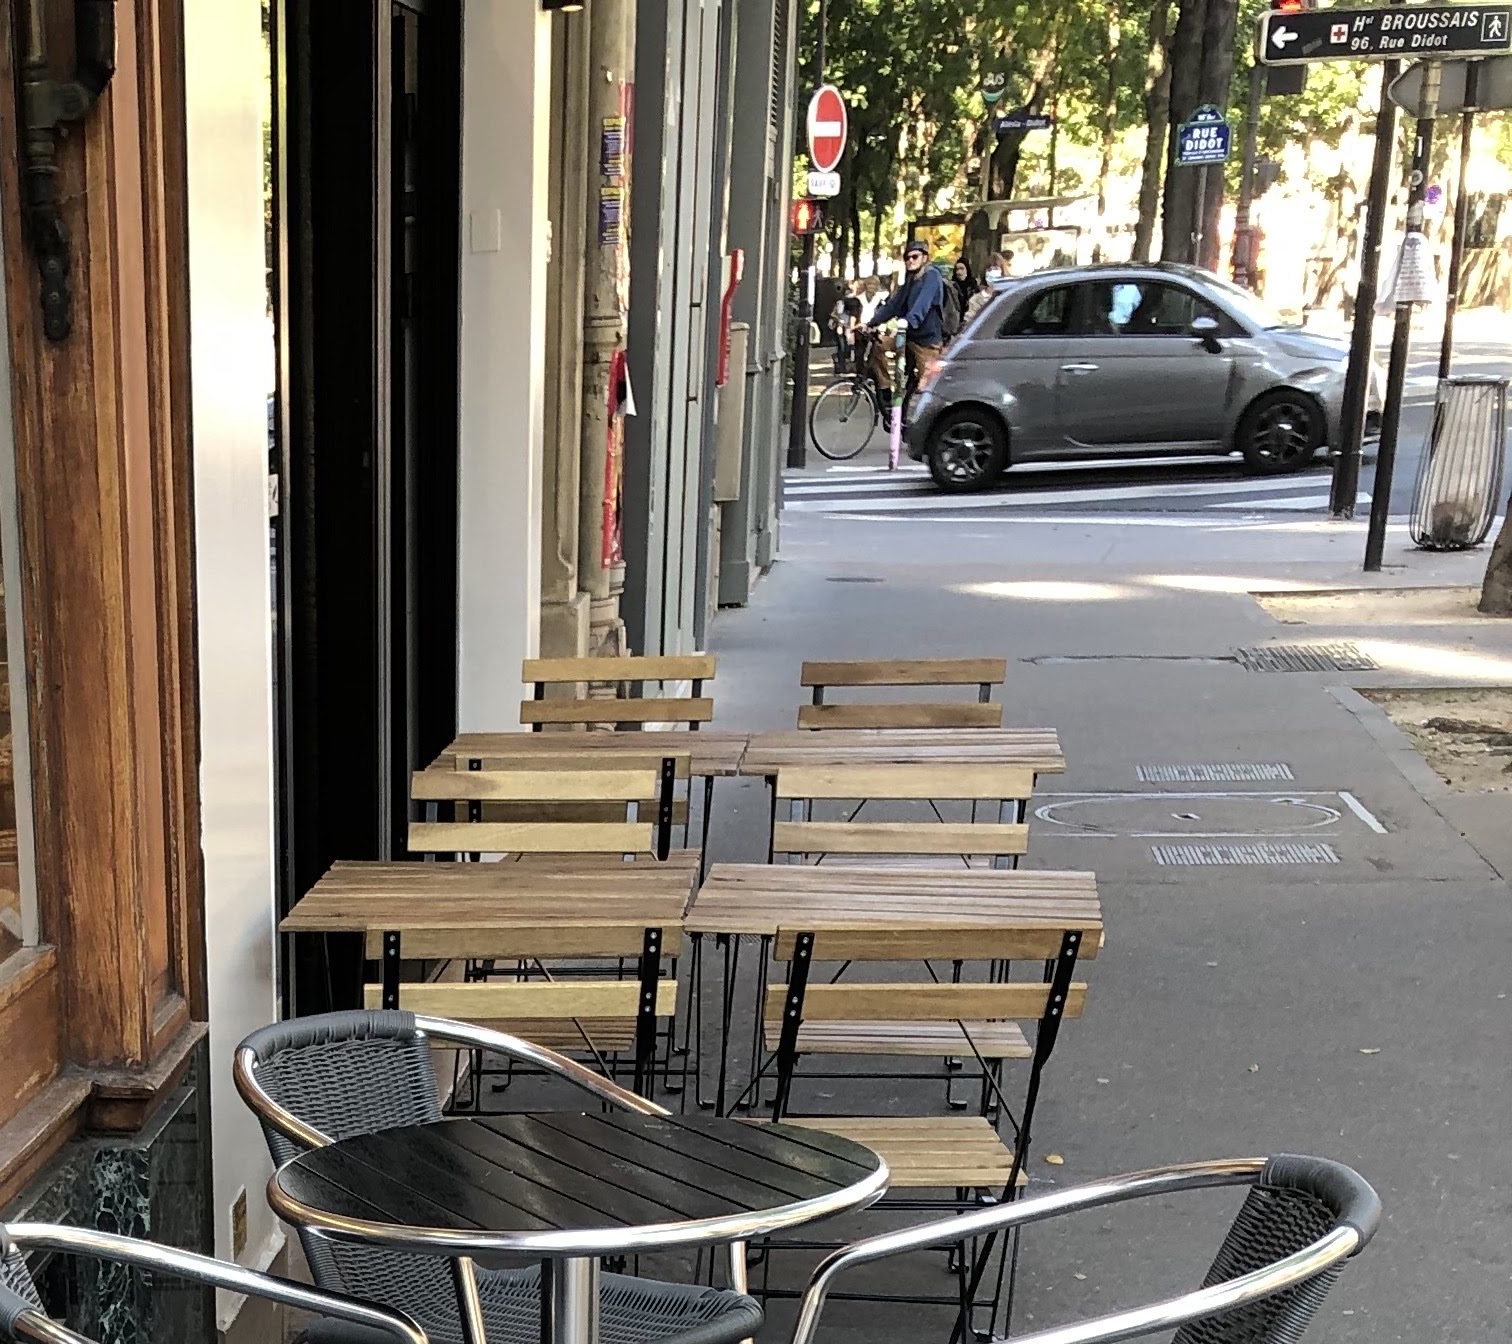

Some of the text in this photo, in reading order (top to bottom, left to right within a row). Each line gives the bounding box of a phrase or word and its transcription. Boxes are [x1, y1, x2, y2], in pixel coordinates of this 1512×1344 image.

[1381, 11, 1479, 31] BROUSSAIS
[1379, 36, 1404, 49] Rue
[1411, 34, 1448, 48] Didot
[1192, 127, 1218, 139] RUE
[1185, 137, 1223, 151] DIDOT
